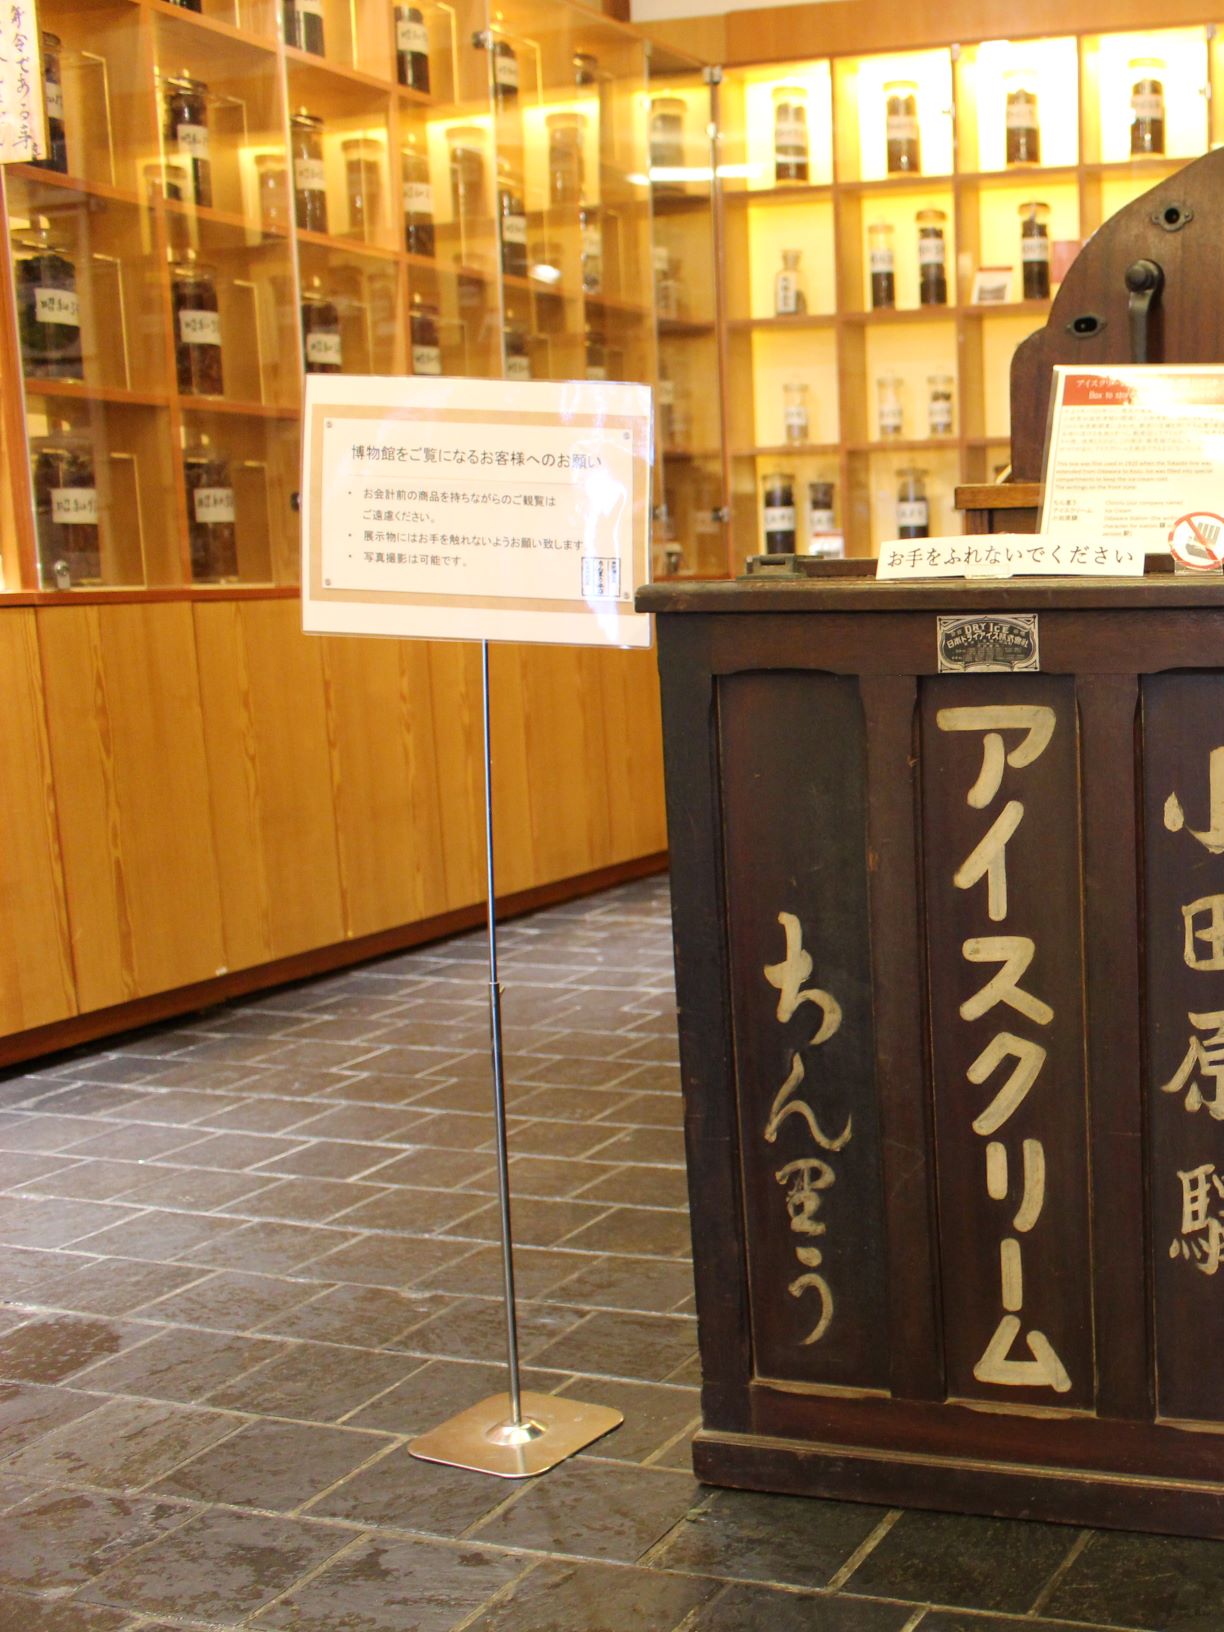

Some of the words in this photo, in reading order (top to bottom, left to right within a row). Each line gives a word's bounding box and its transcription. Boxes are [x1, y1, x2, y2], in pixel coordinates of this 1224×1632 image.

[351, 444, 602, 470] 博物館をご覧になるお客様へのお願い
[363, 552, 468, 567] 写真撮影は可能です。
[887, 545, 1134, 568] お手をふれないでください
[964, 622, 986, 635] DRY
[990, 622, 1010, 634] ICE
[935, 704, 1073, 1393] アイスクリーム
